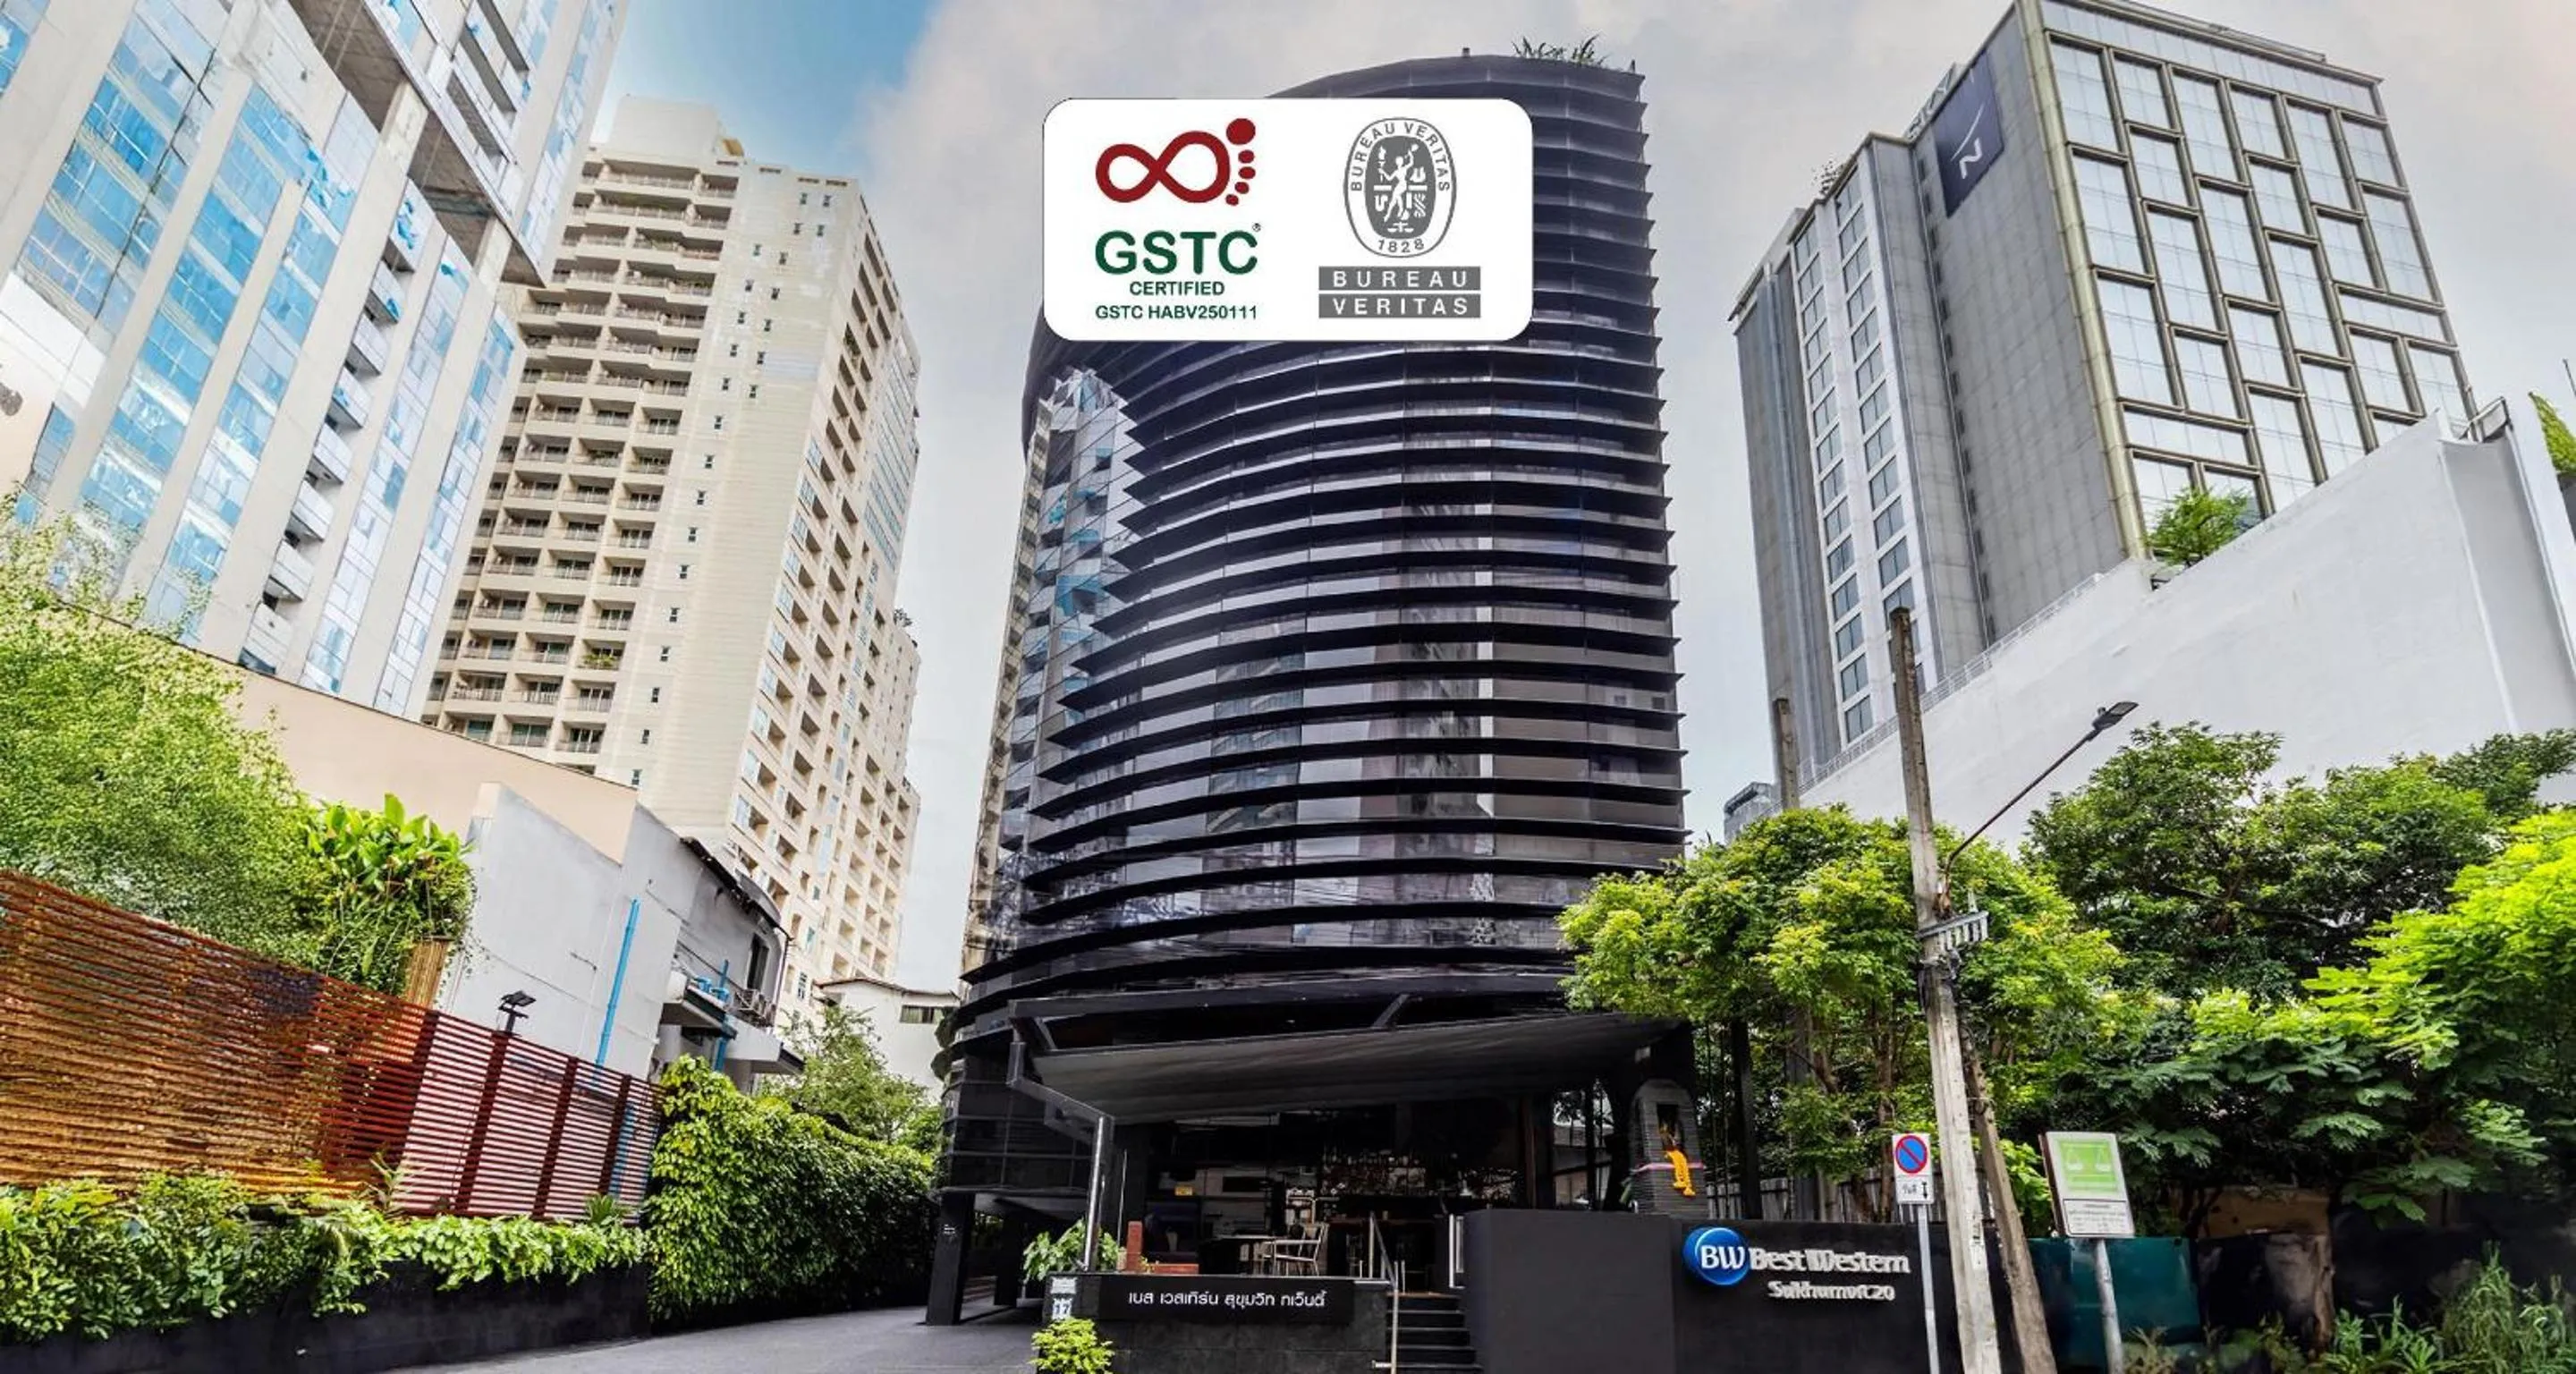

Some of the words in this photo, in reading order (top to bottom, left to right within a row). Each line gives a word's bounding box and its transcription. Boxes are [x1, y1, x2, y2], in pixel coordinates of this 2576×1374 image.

[1700, 1244, 1745, 1270] BW
[1749, 1247, 1806, 1271] Best
[1805, 1249, 1911, 1274] Western
